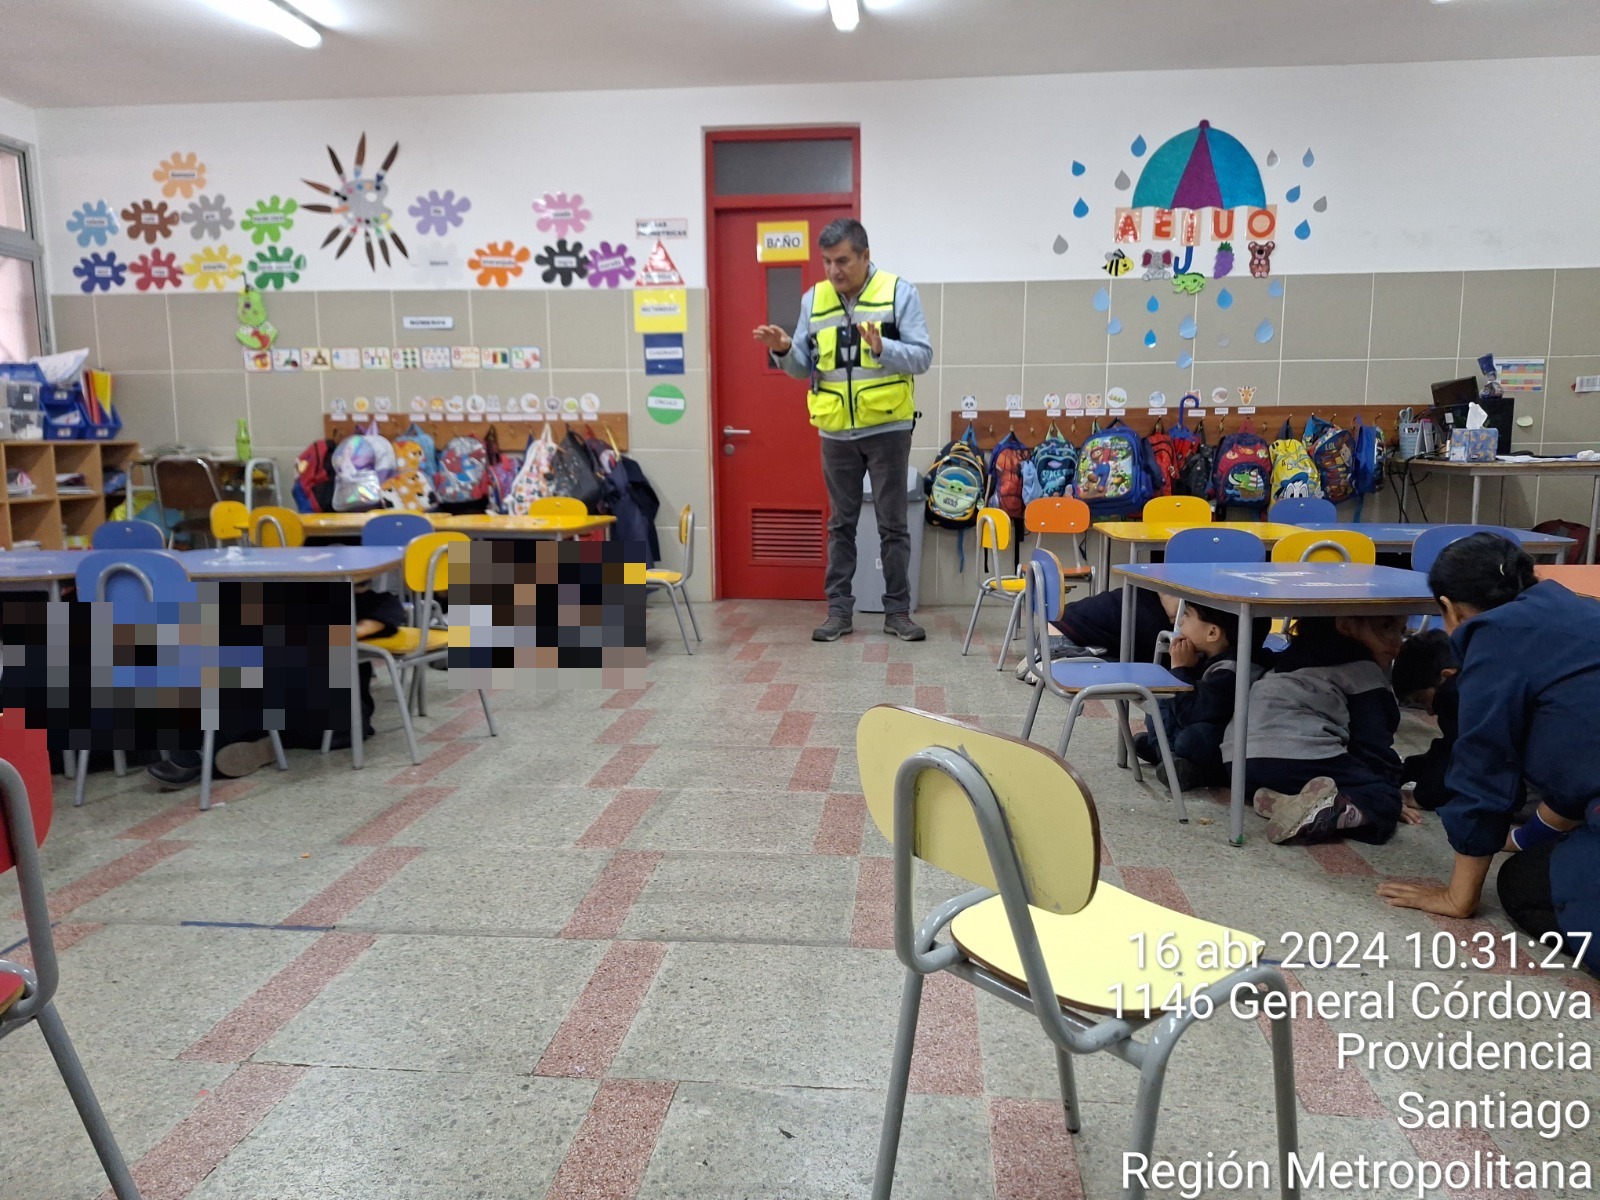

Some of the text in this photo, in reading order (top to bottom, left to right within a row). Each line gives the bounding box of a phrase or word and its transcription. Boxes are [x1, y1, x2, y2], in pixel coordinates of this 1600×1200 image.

[1115, 214, 1138, 243] A
[1154, 209, 1172, 238] E
[1213, 209, 1234, 239] U
[1247, 209, 1276, 238] O
[766, 233, 801, 248] BAÑO
